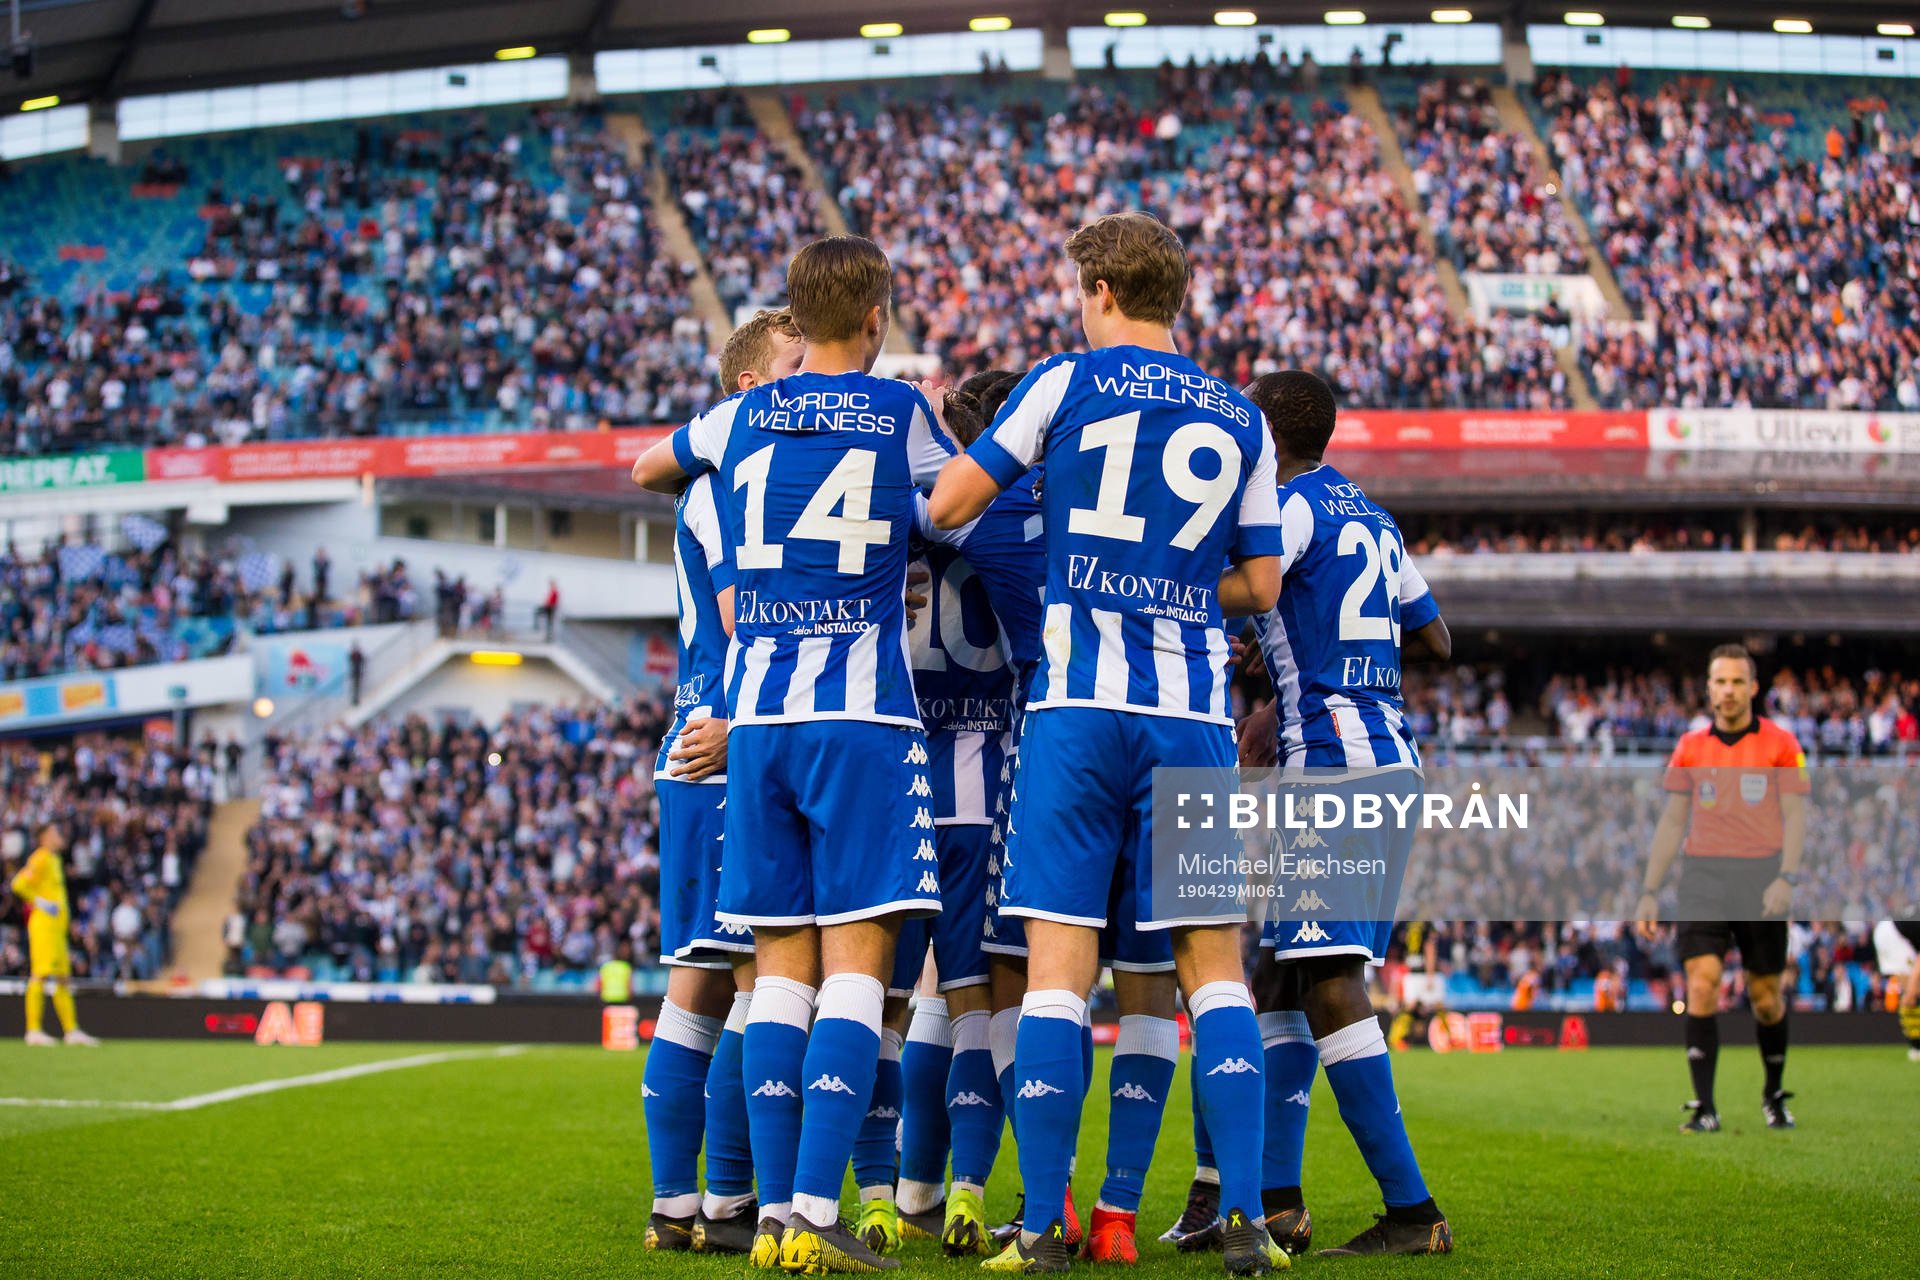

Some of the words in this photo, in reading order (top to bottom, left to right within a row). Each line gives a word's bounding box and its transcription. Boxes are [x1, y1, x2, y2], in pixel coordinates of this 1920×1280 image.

[1122, 362, 1228, 398] NORDIC
[771, 389, 870, 413] NORDIC
[1093, 374, 1250, 428] WELLNESS
[748, 408, 896, 436] WELLNESS
[1067, 409, 1242, 552] 19
[733, 442, 892, 575] 14
[1337, 520, 1400, 648] 28
[814, 621, 869, 635] INSTALCO
[1166, 605, 1208, 624] INSTALCO
